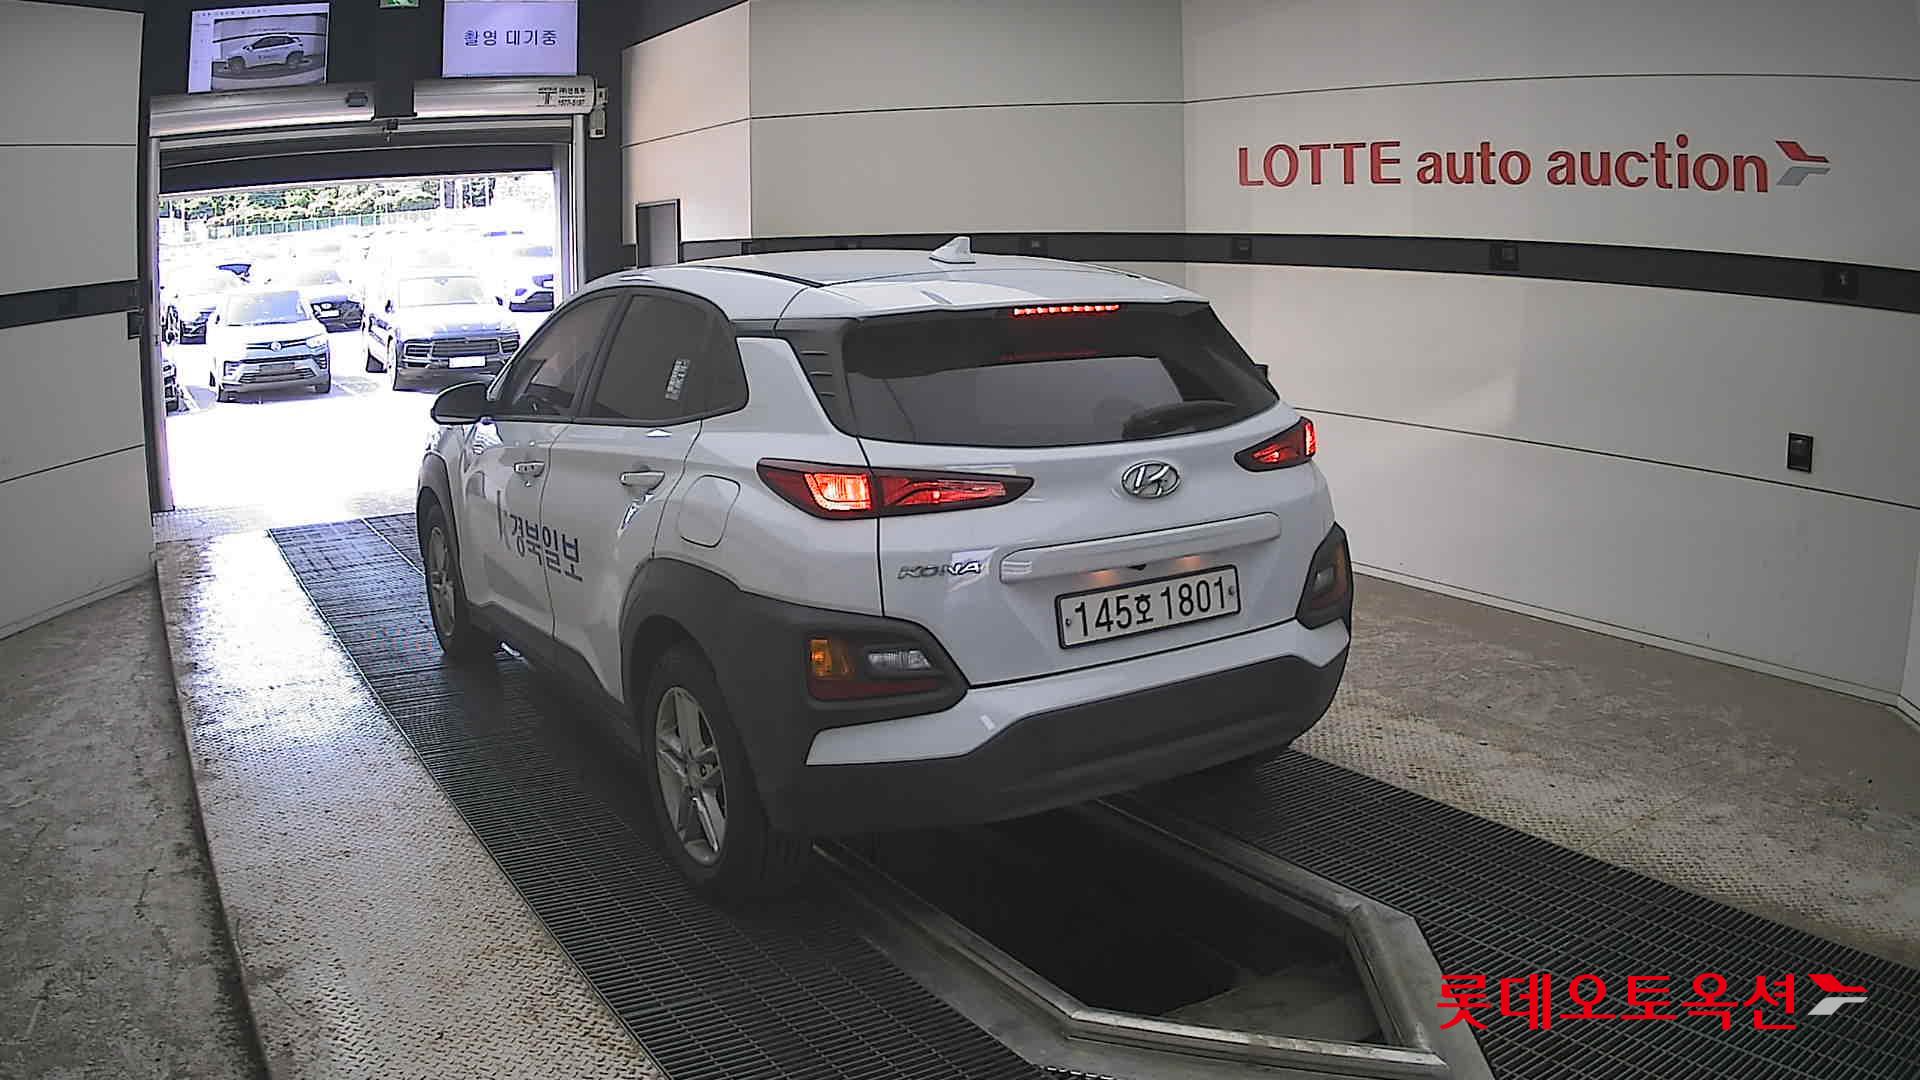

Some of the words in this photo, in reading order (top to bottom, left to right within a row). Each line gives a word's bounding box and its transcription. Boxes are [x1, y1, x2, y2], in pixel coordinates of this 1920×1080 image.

[505, 30, 558, 46] 대기중
[1238, 141, 1401, 187] LOTTE
[1416, 141, 1532, 185] auto
[1546, 134, 1769, 193] auction
[509, 512, 583, 582] 경북일보
[897, 560, 981, 579] KONA
